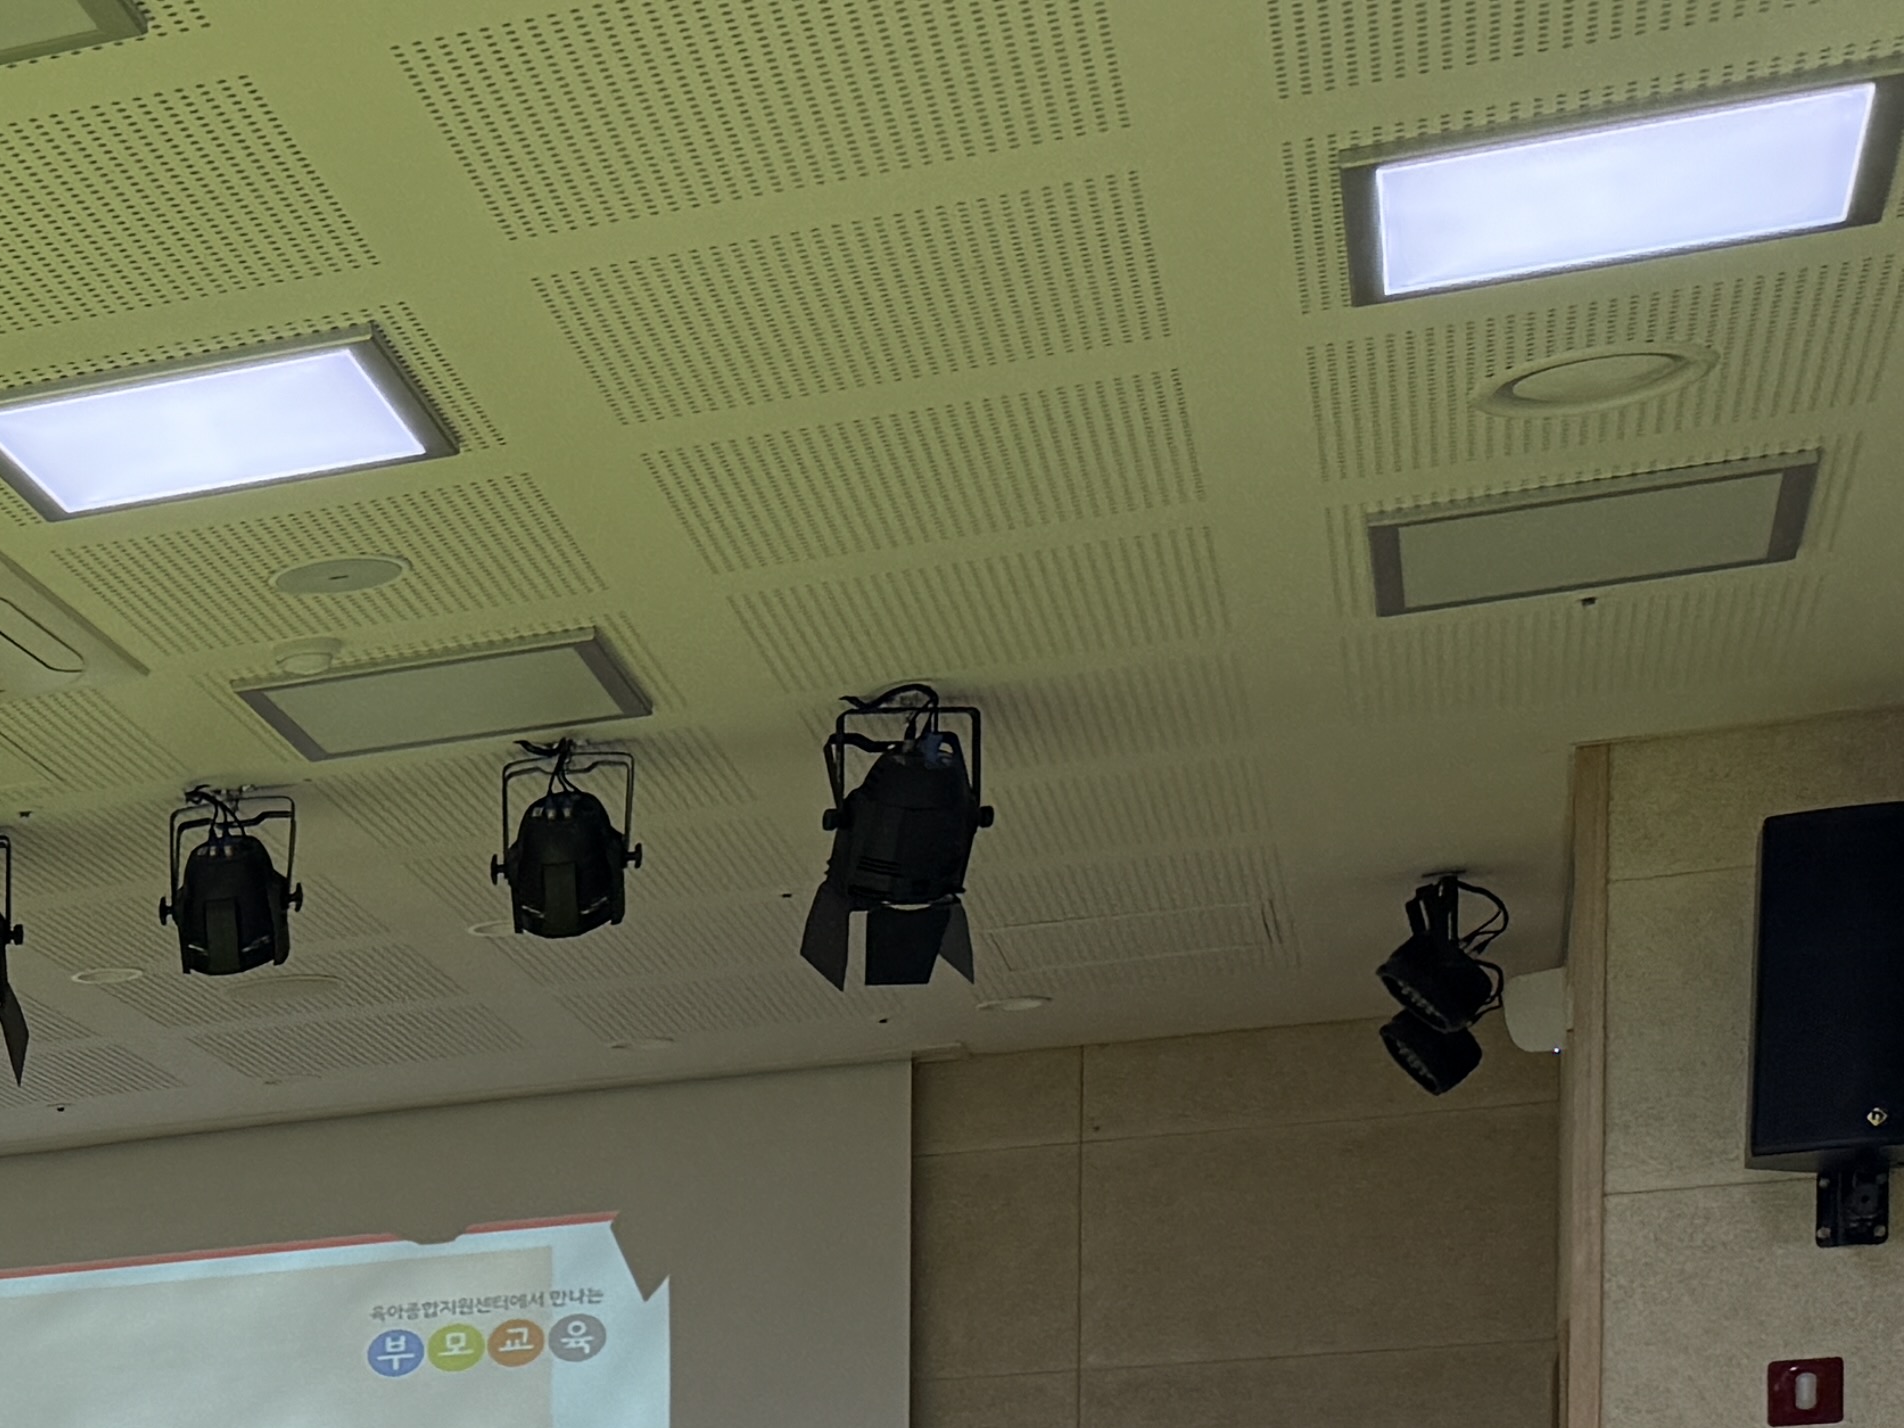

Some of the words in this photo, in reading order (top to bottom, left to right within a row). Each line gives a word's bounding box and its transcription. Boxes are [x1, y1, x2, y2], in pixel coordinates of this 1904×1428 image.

[369, 1291, 545, 1322] 육아종합지원센터에서
[549, 1286, 605, 1308] 만나는
[376, 1319, 595, 1371] 부모교육
